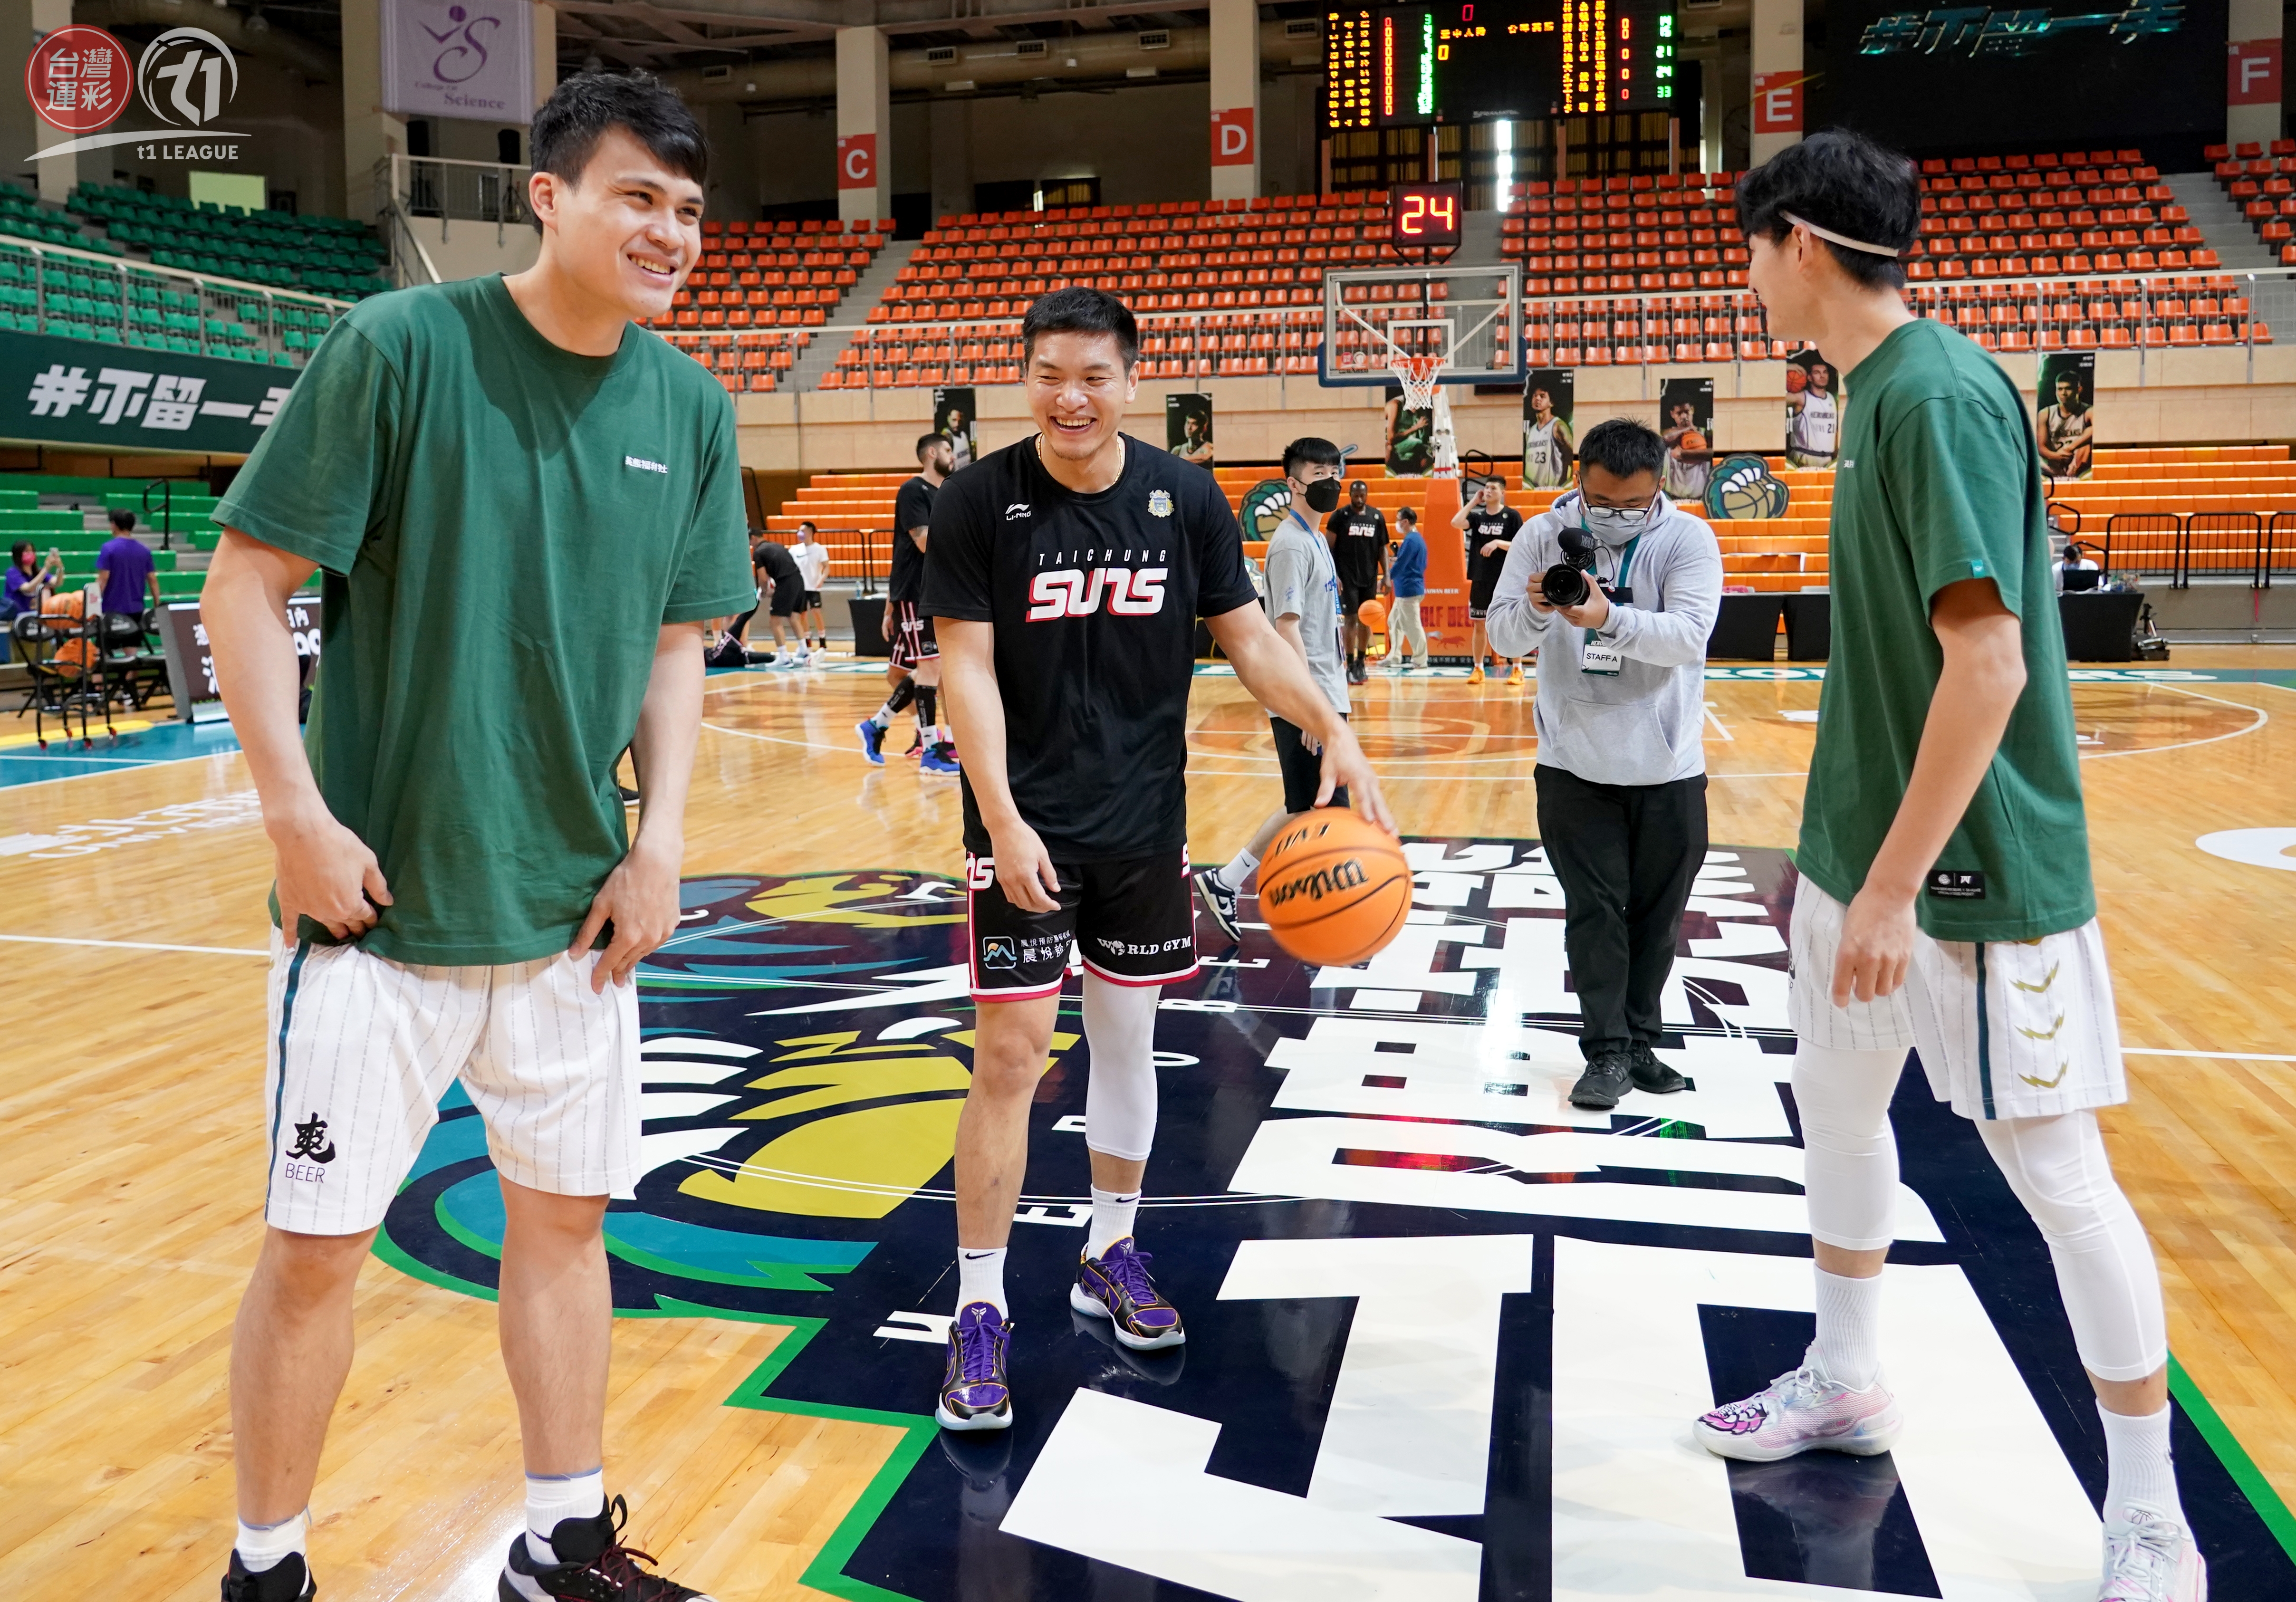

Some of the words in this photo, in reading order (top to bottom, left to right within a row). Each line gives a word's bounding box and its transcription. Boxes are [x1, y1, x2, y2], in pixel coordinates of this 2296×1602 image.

[2241, 57, 2270, 93] F
[443, 94, 506, 110] Science
[1767, 88, 1793, 122] E
[1221, 125, 1247, 155] D
[845, 149, 869, 179] C
[1402, 195, 1453, 234] 24
[1535, 452, 1546, 463] 23
[1039, 548, 1167, 566] TAICHUNG
[1586, 653, 1611, 662] STAFF
[1163, 936, 1191, 951] GYM
[285, 1111, 336, 1164] 爽
[285, 1163, 326, 1183] BEER
